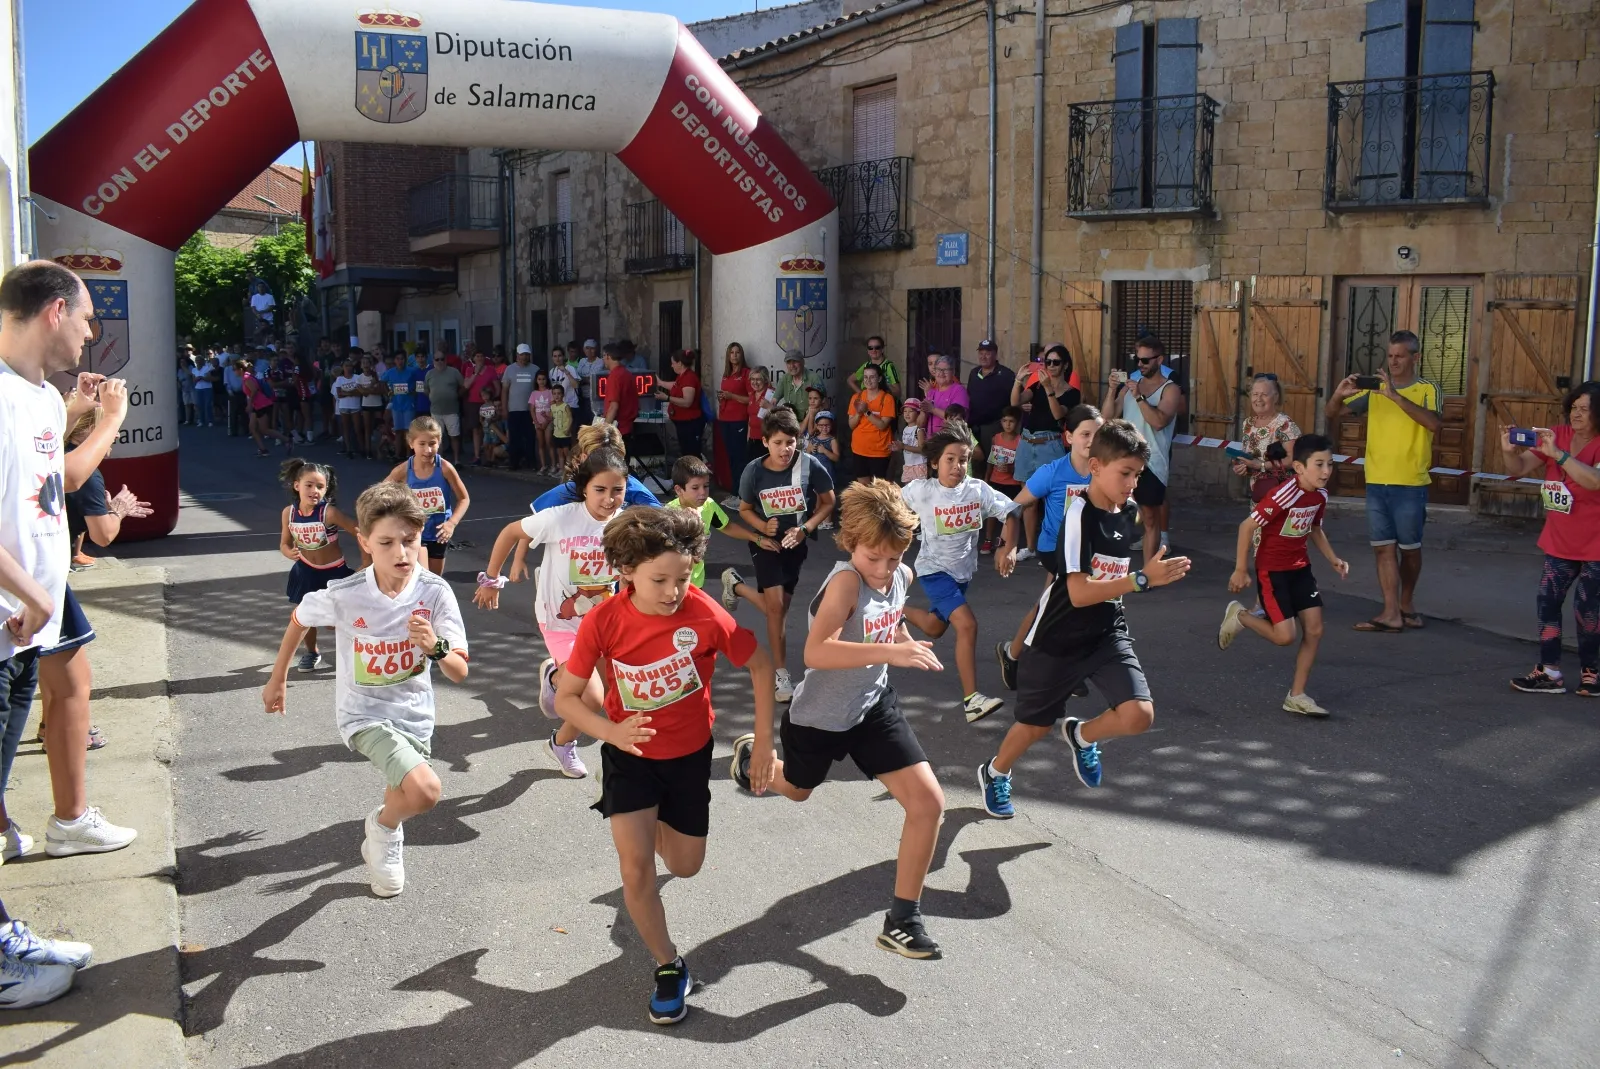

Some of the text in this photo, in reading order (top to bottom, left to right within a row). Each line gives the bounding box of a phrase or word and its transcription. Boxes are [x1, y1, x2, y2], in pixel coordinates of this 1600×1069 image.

[435, 32, 572, 62] Diputación
[434, 83, 596, 111] de Salamanca
[82, 48, 272, 215] CON EL DEPORTE
[685, 74, 807, 211] CON NUESTROS
[671, 100, 784, 223] DEPORTISTAS
[760, 487, 802, 500] bedunia
[1548, 491, 1568, 506] 188
[422, 497, 438, 509] 69
[771, 496, 797, 510] 470
[935, 502, 980, 517] bedunia
[944, 512, 973, 529] 466
[297, 533, 321, 545] 454
[570, 550, 606, 561] bedu
[354, 637, 415, 655] bedun
[366, 651, 414, 676] 460
[614, 656, 692, 683] bedunia
[633, 672, 682, 701] 465
